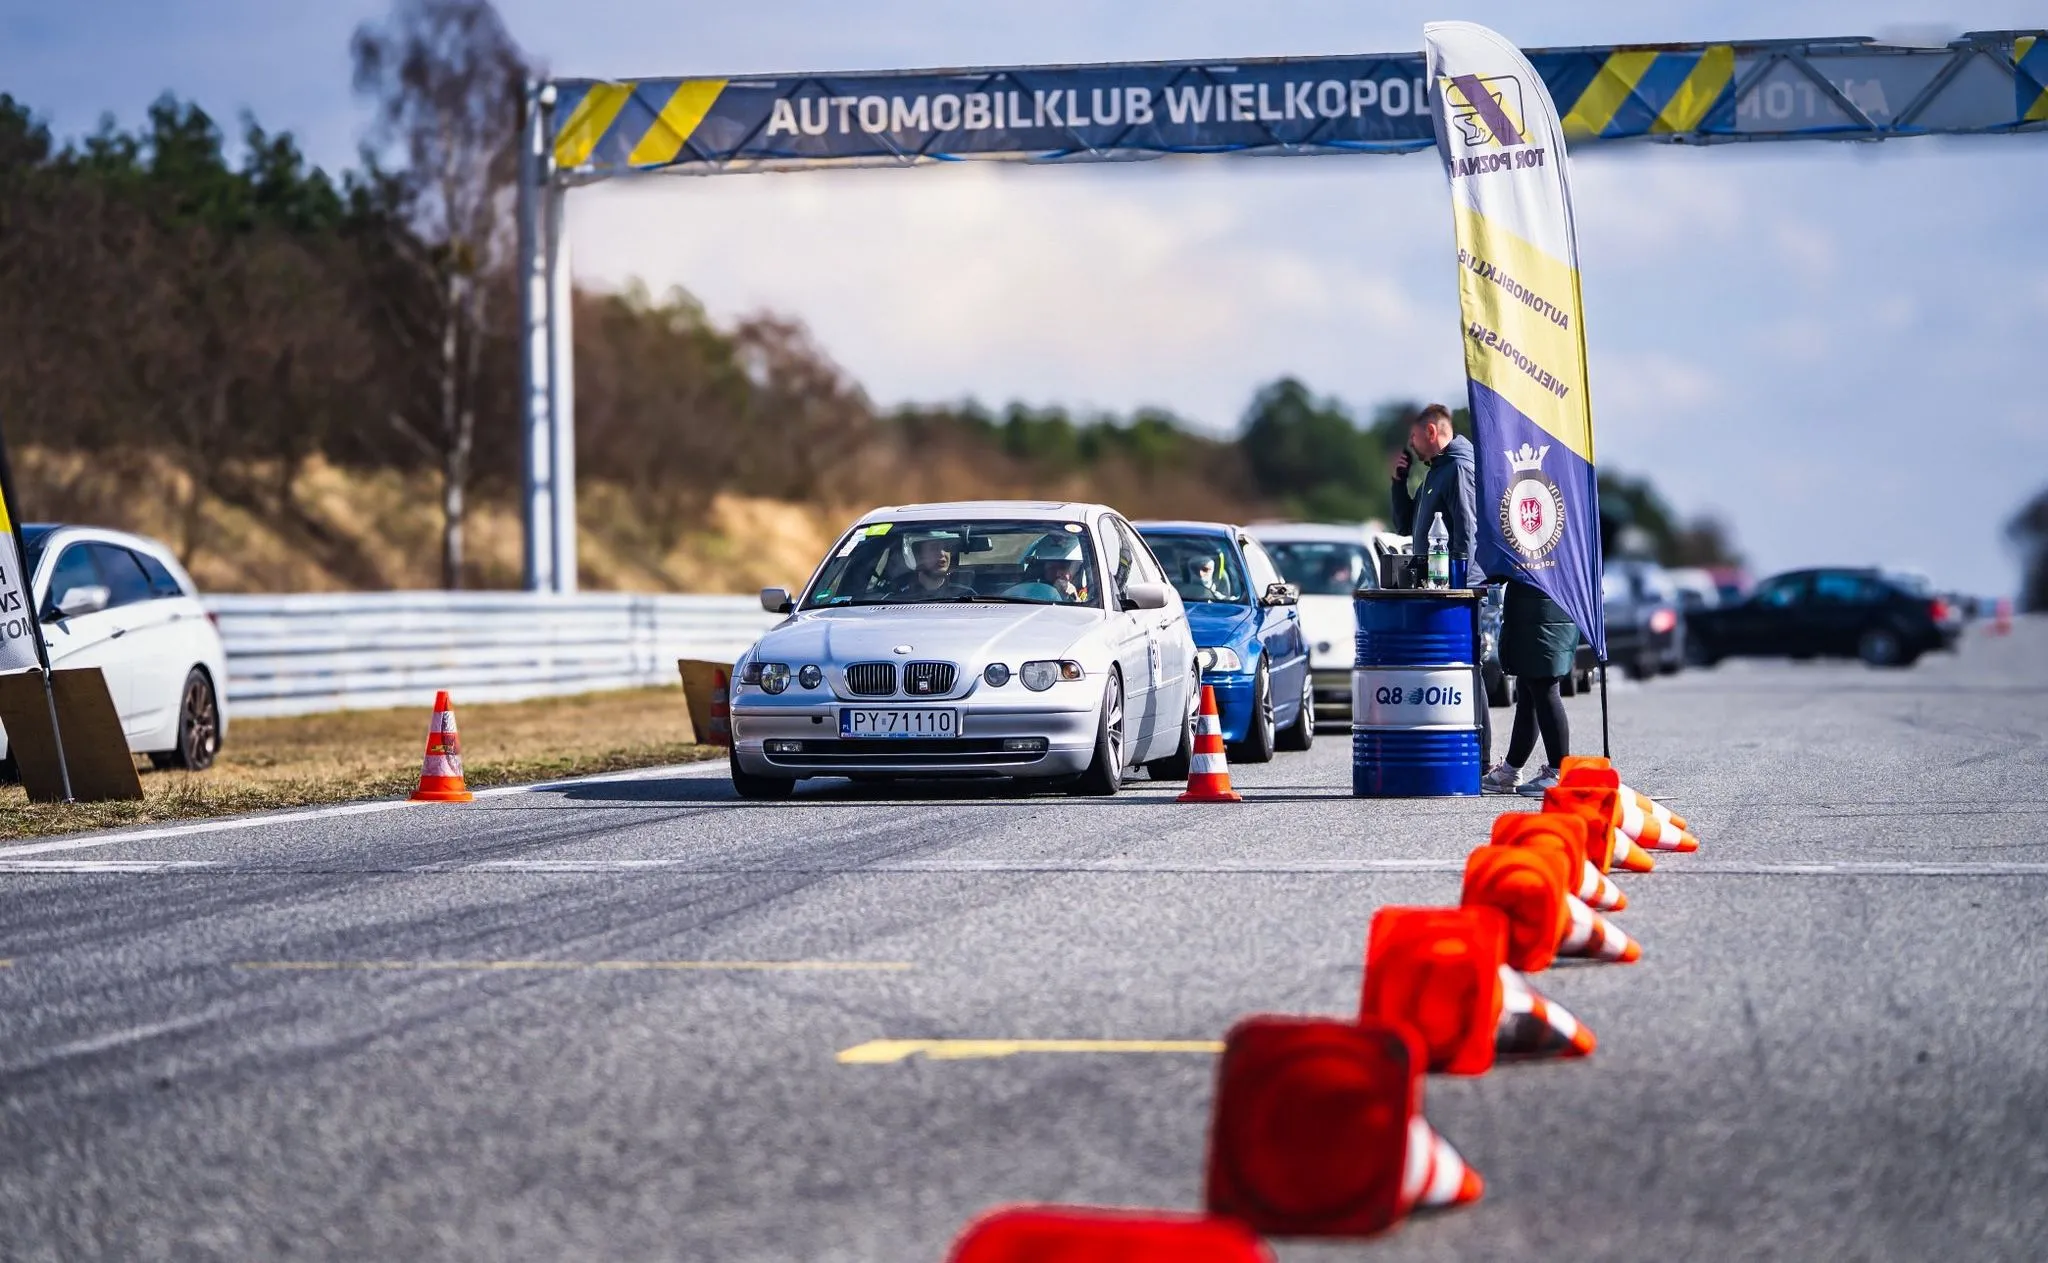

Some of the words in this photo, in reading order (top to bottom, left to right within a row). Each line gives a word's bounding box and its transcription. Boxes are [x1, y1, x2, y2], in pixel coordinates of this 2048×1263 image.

[767, 87, 1153, 135] AUTOMOBILKLUB
[1376, 686, 1403, 705] Q8
[1425, 686, 1462, 706] Oils
[854, 712, 879, 731] PY
[887, 712, 950, 731] 71110
